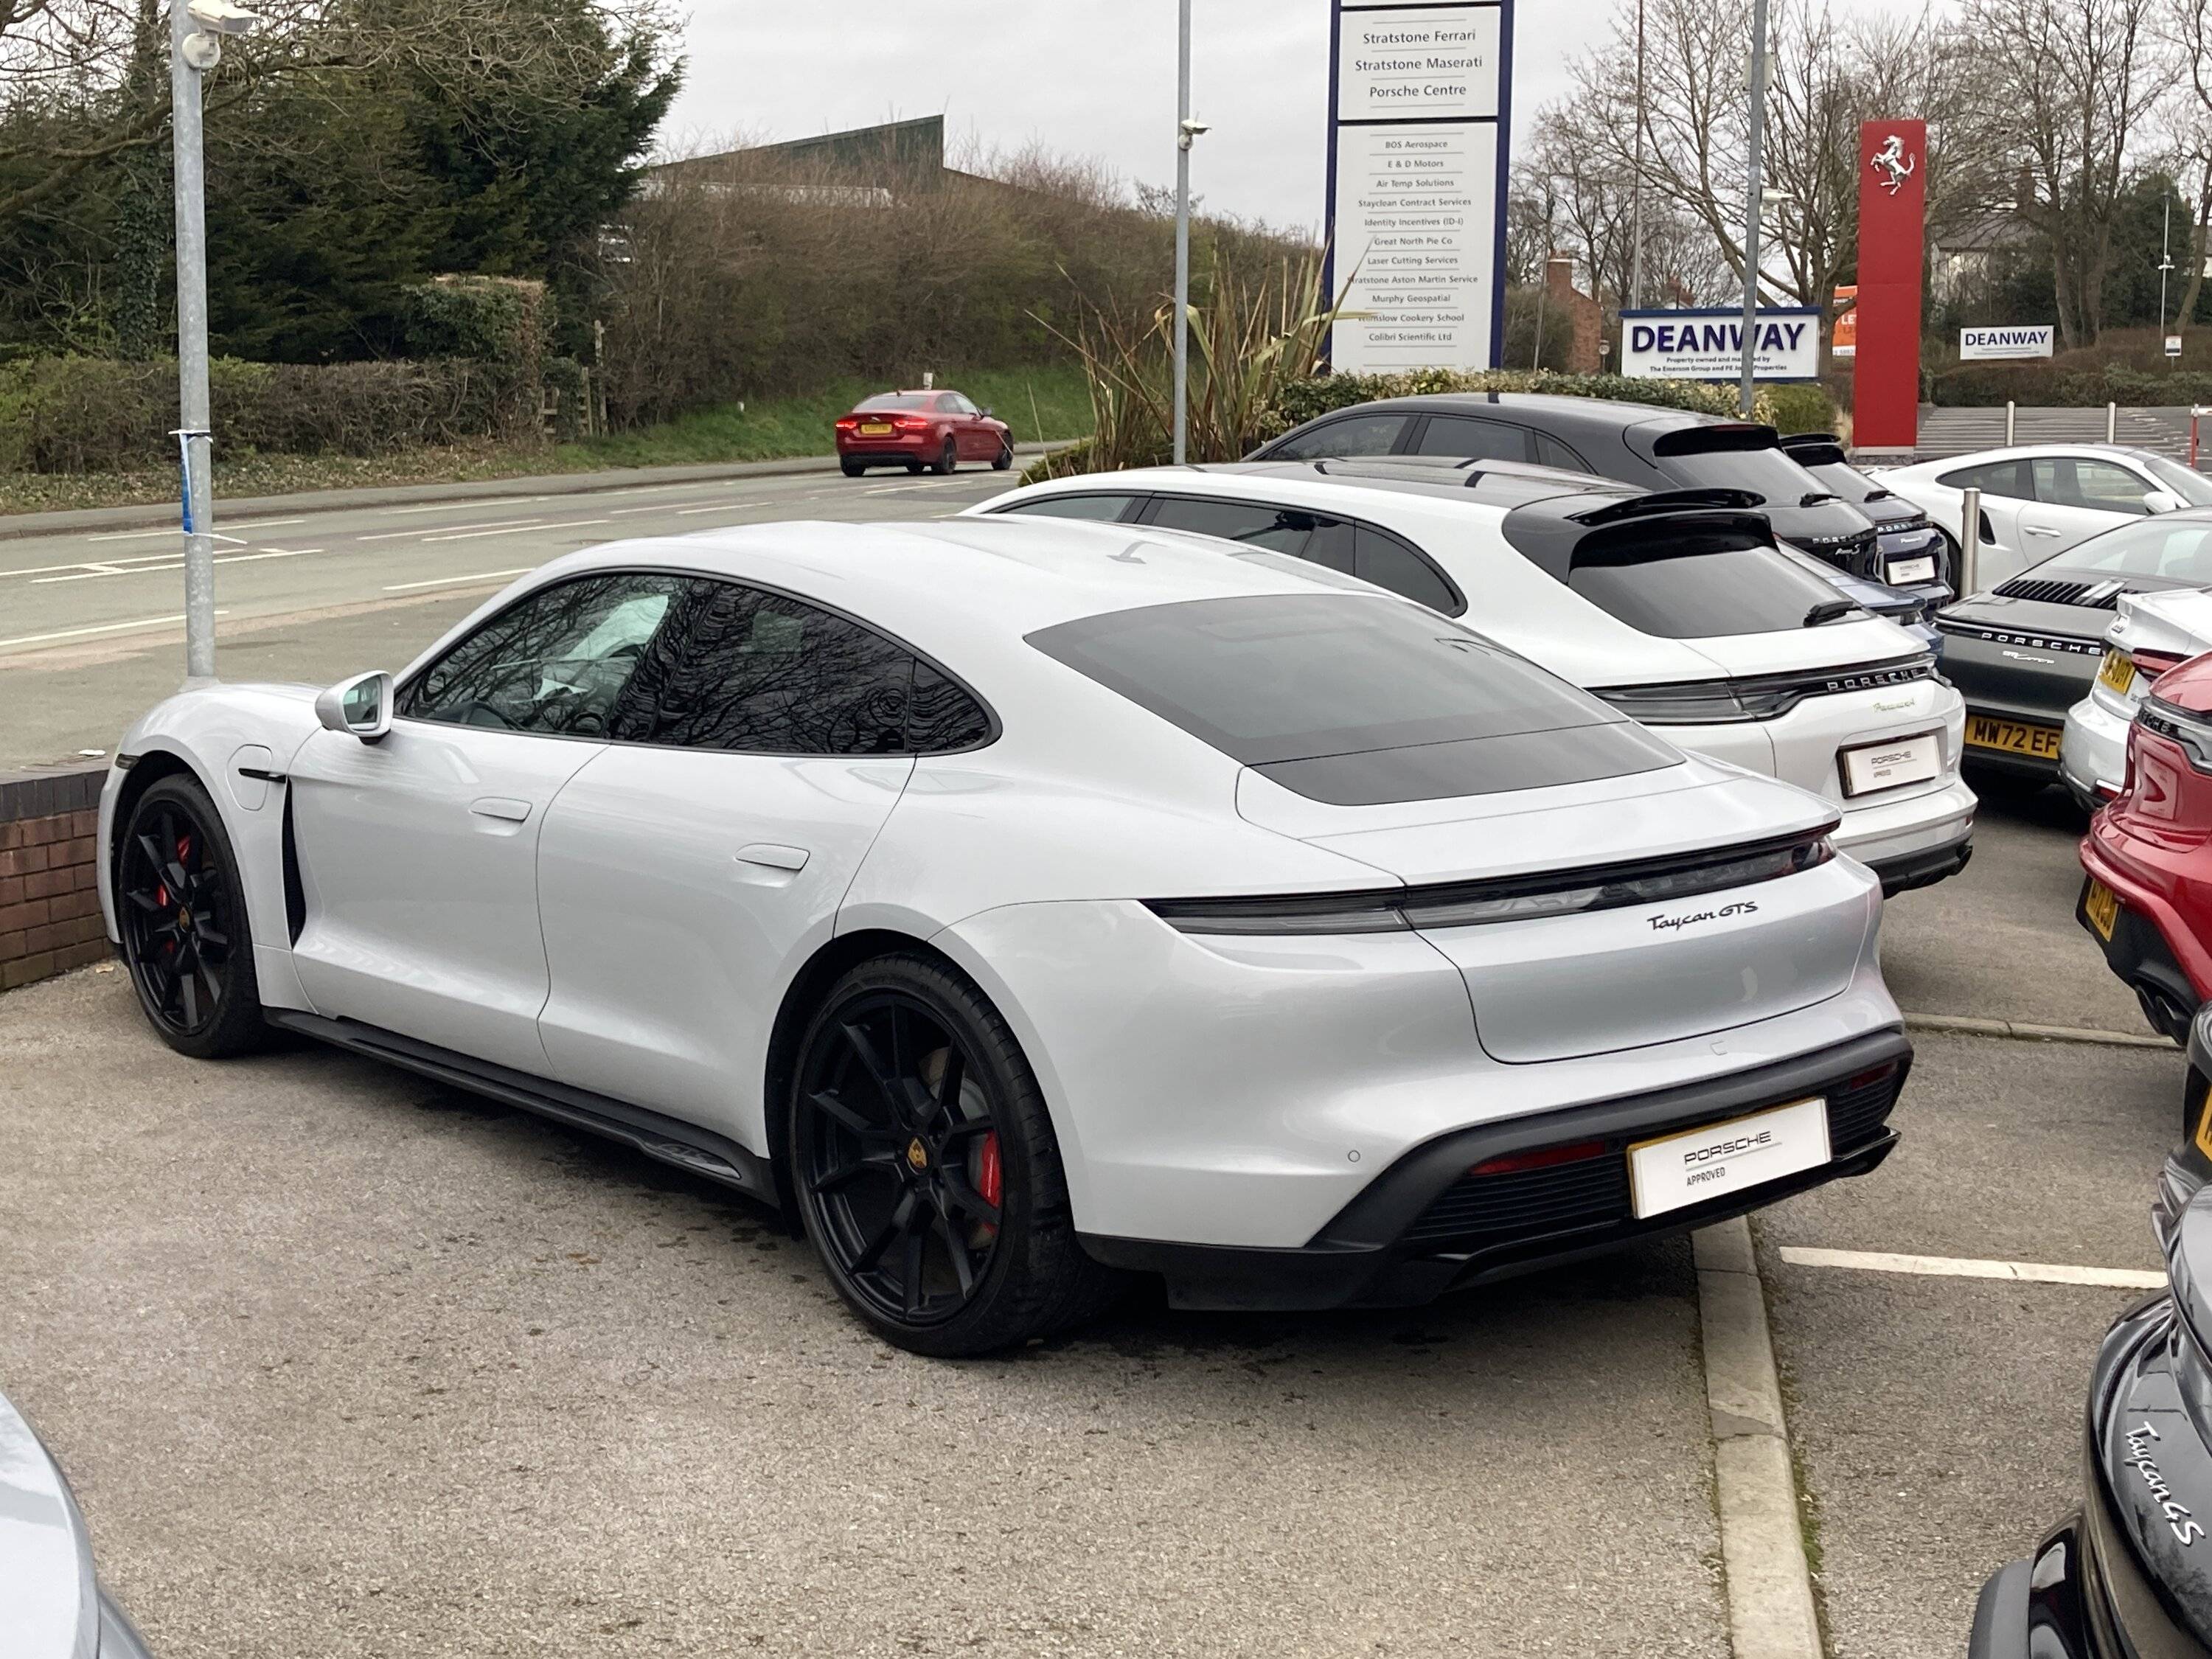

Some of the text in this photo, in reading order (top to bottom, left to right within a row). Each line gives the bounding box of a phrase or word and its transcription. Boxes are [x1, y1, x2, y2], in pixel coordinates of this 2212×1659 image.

[1363, 29, 1476, 44] Stratstone Ferrari
[1354, 55, 1483, 72] Stratstone Maserati
[1369, 85, 1467, 97] Porsche Centre
[1385, 141, 1448, 150] BOS Aerospace
[1396, 160, 1402, 168] &
[1391, 180, 1413, 189] Temp
[1415, 179, 1454, 187] Solutions
[1358, 199, 1397, 209] Stayclean
[1439, 198, 1472, 206] Services
[1365, 219, 1397, 228] Identity
[1374, 237, 1397, 246] Great
[1391, 257, 1422, 265] Cutting
[1347, 275, 1478, 284] ratstone Aston Martin Service
[1372, 294, 1451, 305] Murphy Geospatial
[1400, 314, 1434, 323] Cookery
[1437, 313, 1464, 321] School
[1841, 314, 1857, 325] LE
[1369, 333, 1452, 341] Colibri Scientific Ltd
[1965, 331, 2048, 346] DEANWAY
[1981, 632, 2101, 655] PORSCHE
[1827, 669, 1919, 692] PORSCHE
[1973, 720, 2061, 753] MW72 EF
[1871, 751, 1912, 765] PORSCHE
[1647, 901, 1759, 931] Taycan GTS
[1683, 1130, 1772, 1165] PORSCHE
[1686, 1166, 1726, 1186] APPROVED
[2124, 1420, 2207, 1547] Taycan 4S
